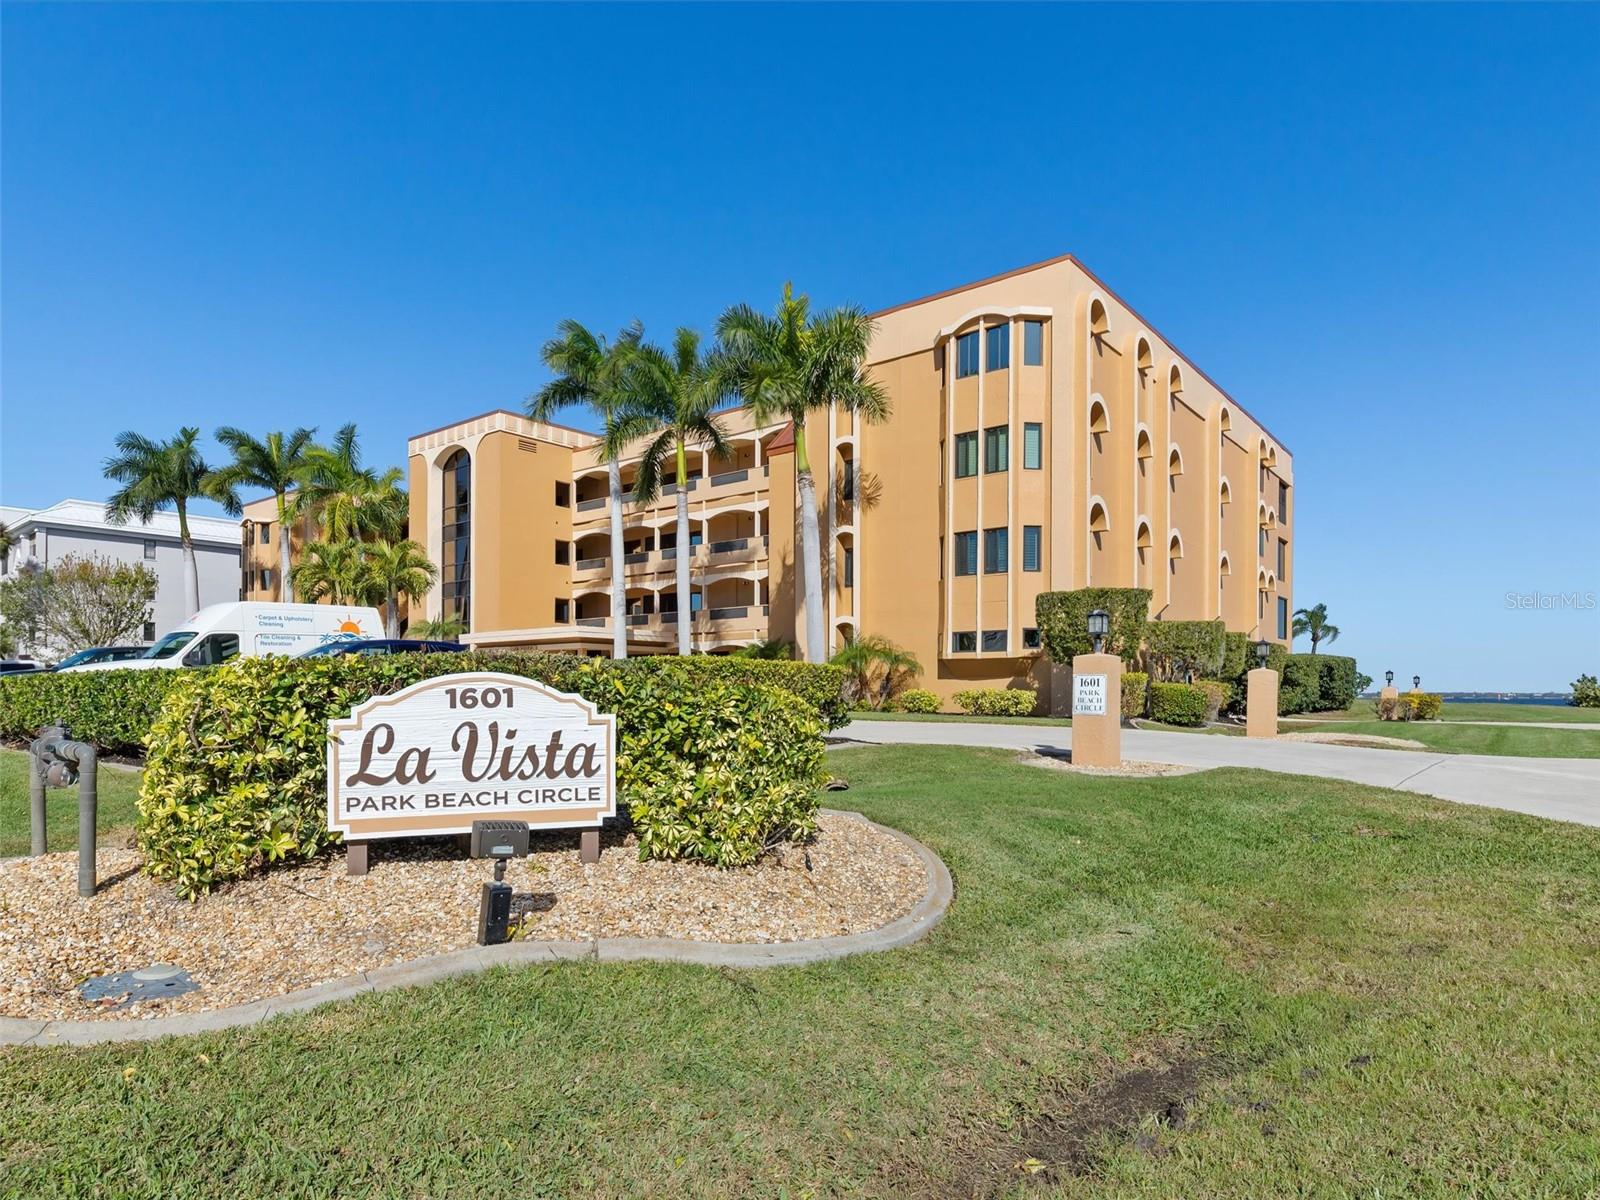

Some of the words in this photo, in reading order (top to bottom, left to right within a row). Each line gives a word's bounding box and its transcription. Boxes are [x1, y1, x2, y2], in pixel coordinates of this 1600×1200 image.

[1080, 678, 1100, 687] 1601
[444, 687, 514, 709] 1601
[346, 723, 437, 787] La
[451, 720, 601, 782] Vista
[346, 794, 415, 812] PARK
[424, 790, 509, 808] BEACH
[517, 787, 601, 805] CIRCLE
